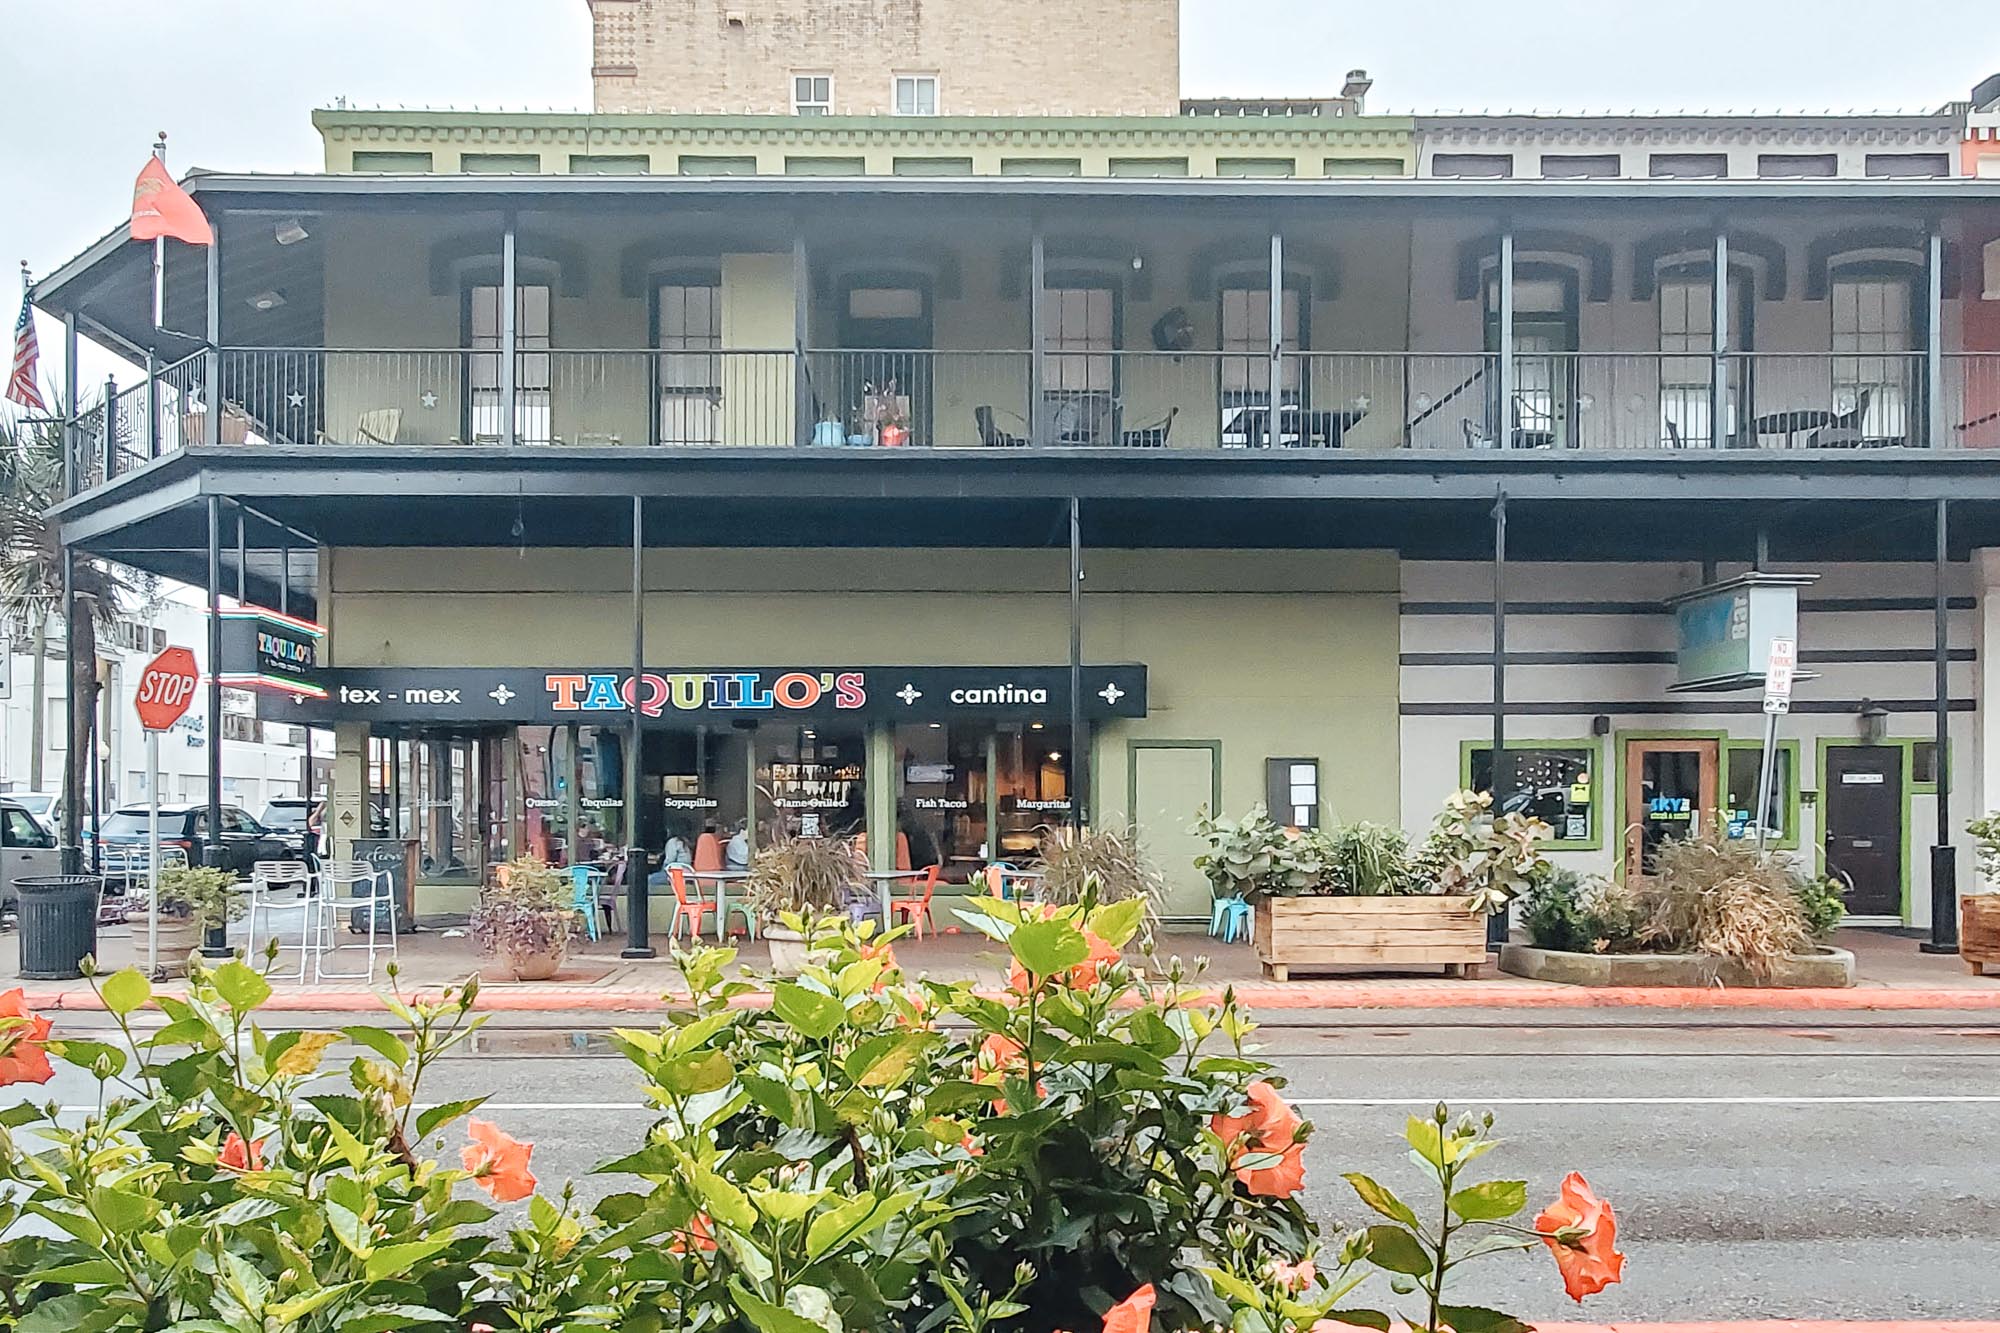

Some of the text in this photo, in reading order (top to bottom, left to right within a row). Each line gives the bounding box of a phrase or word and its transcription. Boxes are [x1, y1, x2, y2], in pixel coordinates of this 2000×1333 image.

[140, 670, 195, 706] STOP
[339, 685, 381, 703] tex
[405, 689, 461, 703] mex
[950, 683, 1047, 704] cantina
[545, 673, 867, 717] TAQUILO'S
[525, 798, 559, 809] Queso
[580, 797, 623, 809] Tequilas
[664, 797, 717, 809] Sopapillas
[809, 798, 848, 808] Grilled
[915, 798, 967, 808] Fish Tacos
[1016, 798, 1071, 810] Margaritas
